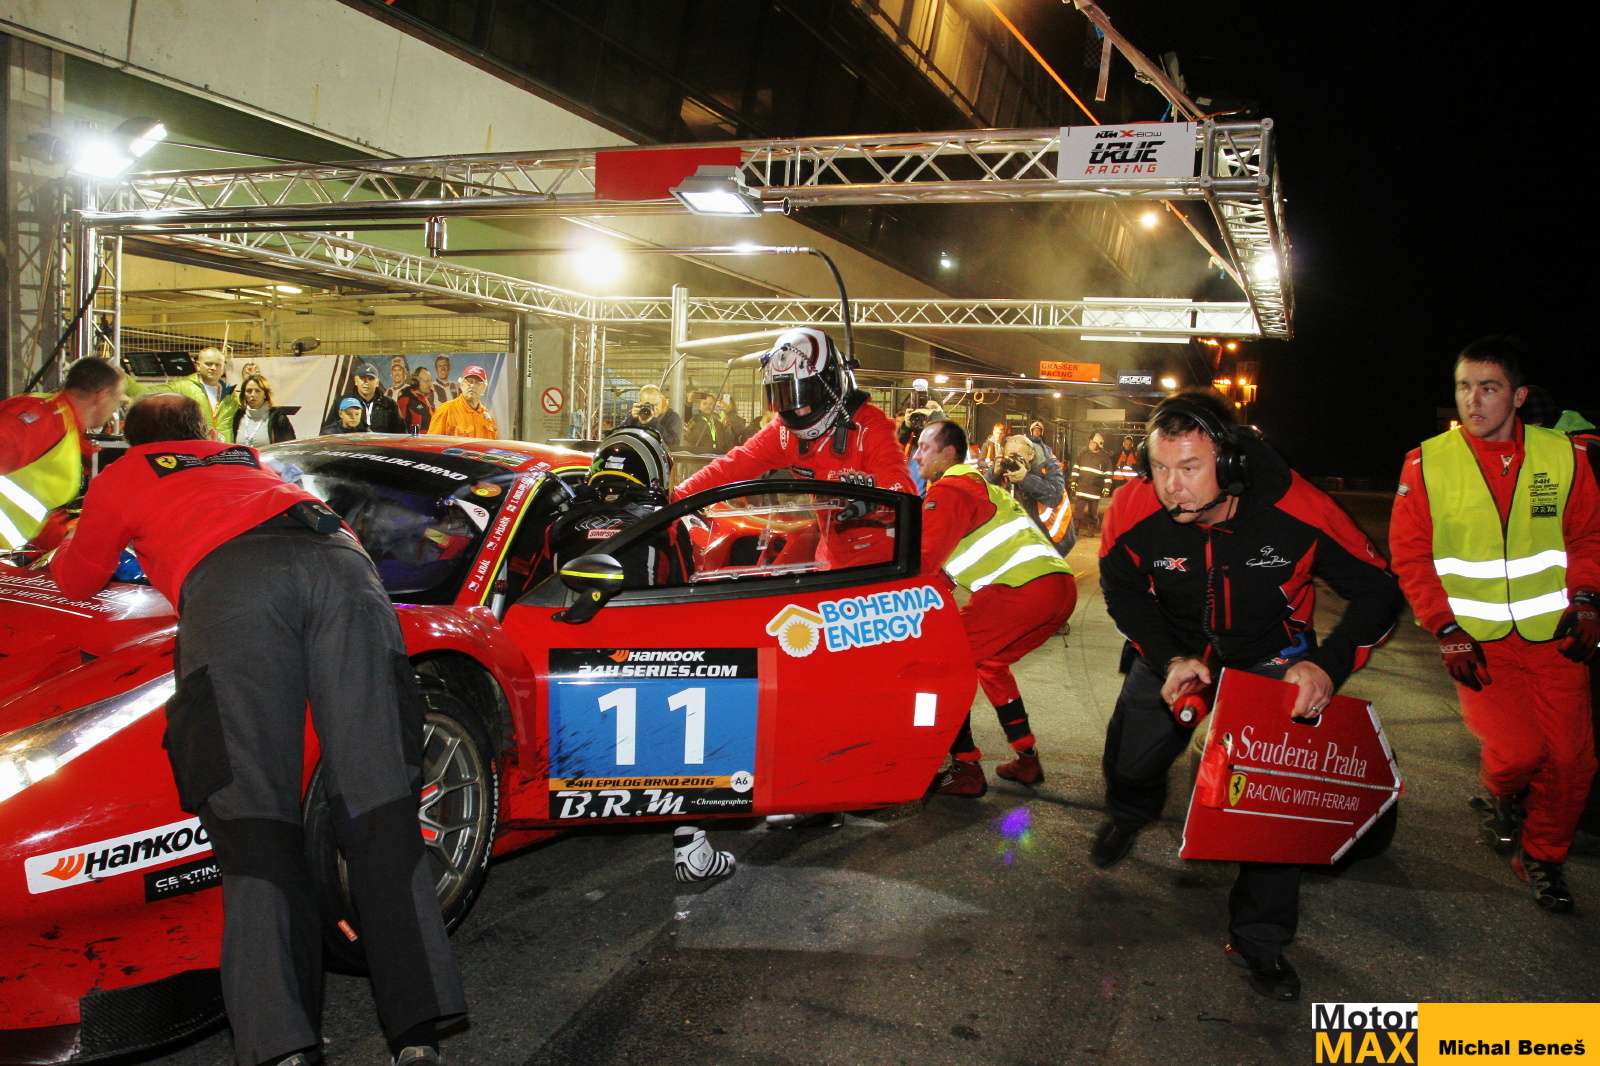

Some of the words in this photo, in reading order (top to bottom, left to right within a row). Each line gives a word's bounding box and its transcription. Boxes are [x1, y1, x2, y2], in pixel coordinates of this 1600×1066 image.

[1095, 130, 1118, 138] KTM
[1041, 370, 1073, 378] RACING
[411, 462, 469, 482] BRNO
[821, 587, 942, 623] BOHEMIA
[827, 613, 921, 649] ENERGY
[598, 687, 706, 766] 11
[1236, 725, 1319, 770] Scuderia
[1321, 741, 1368, 778] Praha
[565, 779, 593, 788] 24H
[596, 778, 641, 788] EPILOG
[643, 778, 679, 787] BRNO
[680, 777, 715, 786] 2016
[735, 777, 749, 786] A6
[1246, 782, 1293, 804] RACING
[1292, 788, 1321, 807] WITH
[1321, 792, 1360, 812] FERRARI
[84, 822, 210, 875] Hankoo
[155, 864, 220, 888] CERTIN
